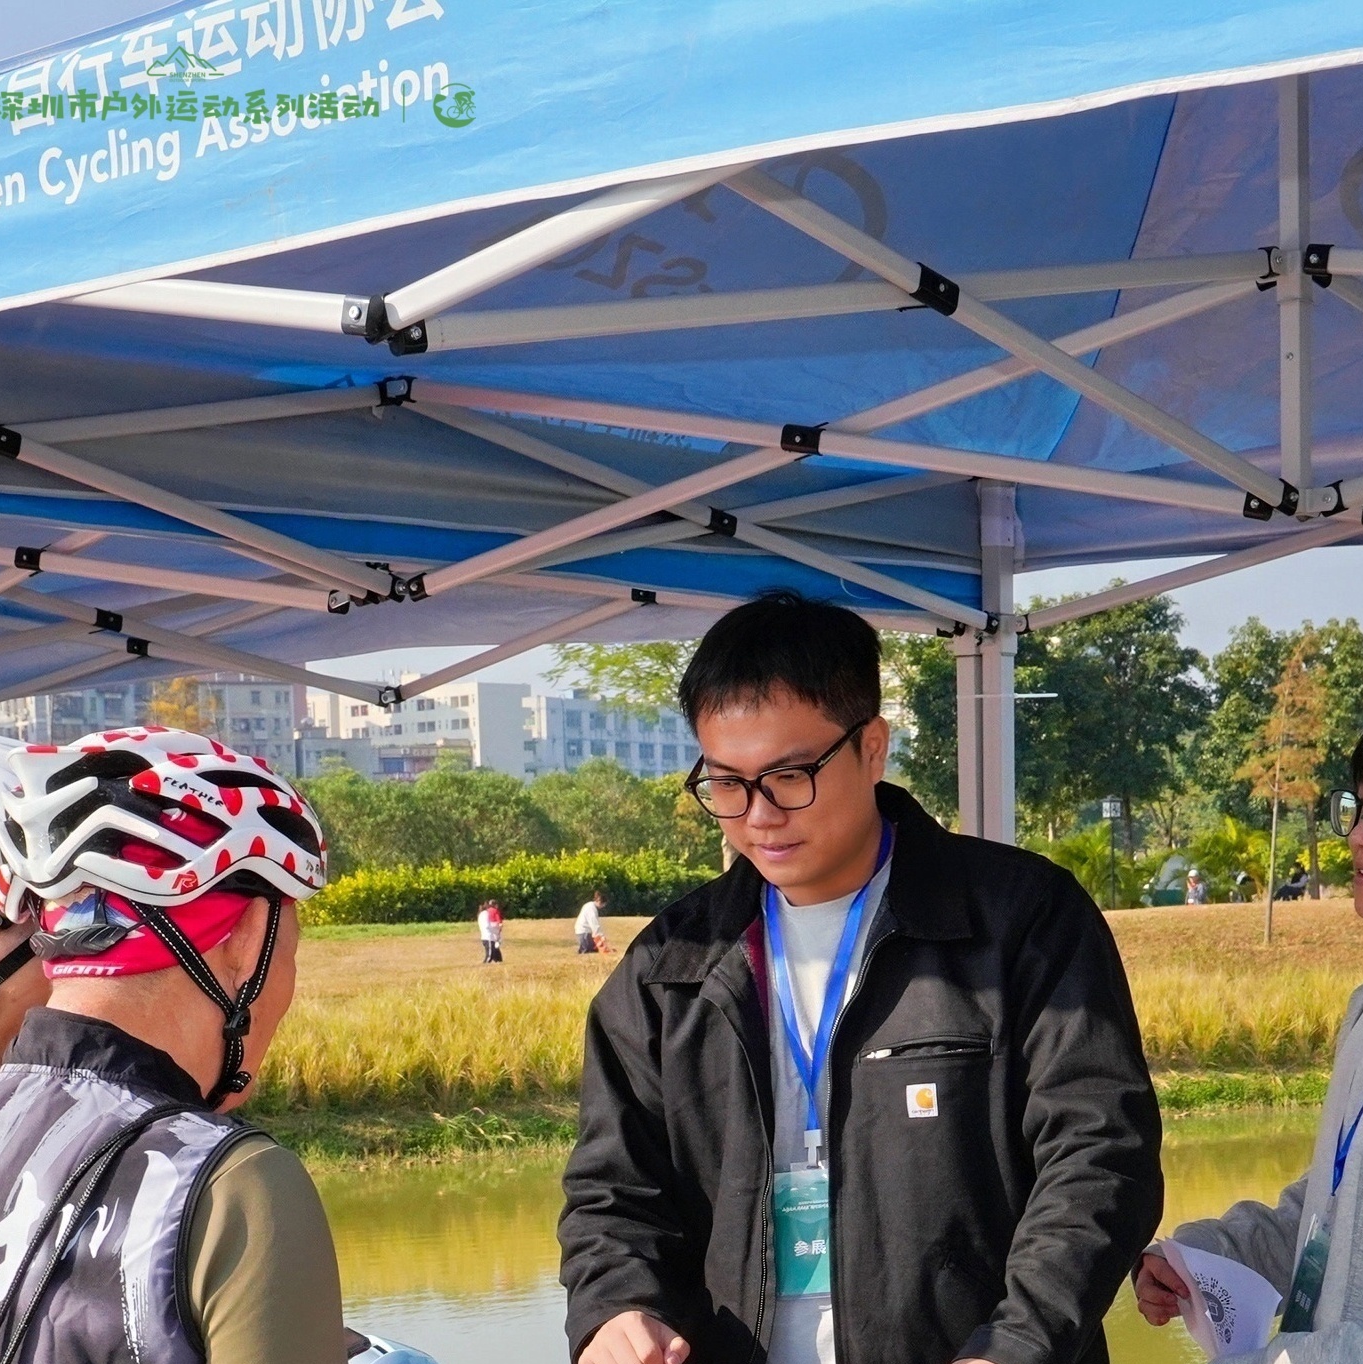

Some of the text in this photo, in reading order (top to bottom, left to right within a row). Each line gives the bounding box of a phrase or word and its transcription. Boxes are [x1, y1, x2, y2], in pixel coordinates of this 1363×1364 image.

[38, 126, 182, 206] Cycling
[194, 62, 449, 160] Association
[52, 964, 125, 976] GIANT
